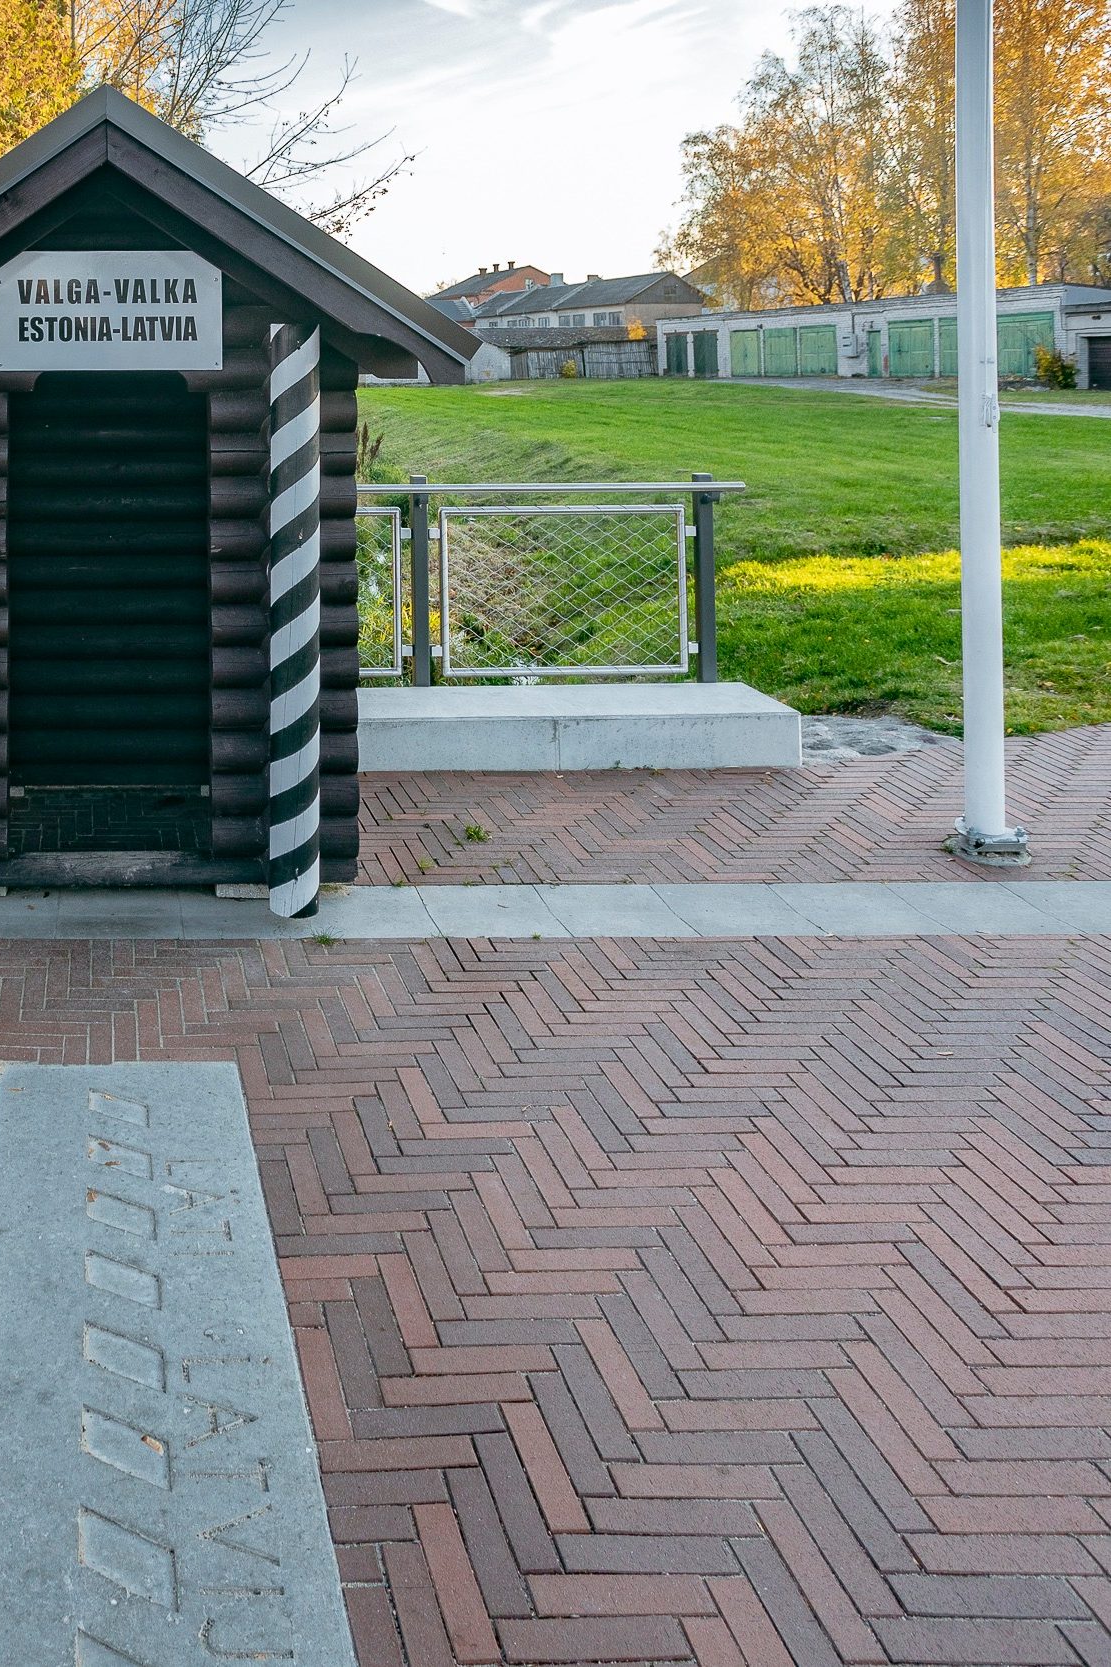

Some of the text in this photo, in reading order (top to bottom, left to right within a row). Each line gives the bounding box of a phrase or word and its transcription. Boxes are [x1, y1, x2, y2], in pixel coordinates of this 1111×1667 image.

[17, 278, 198, 304] VALGA-VALKA
[18, 316, 198, 342] ESTONIA-LATVIA
[165, 1159, 239, 1256] LÄTI
